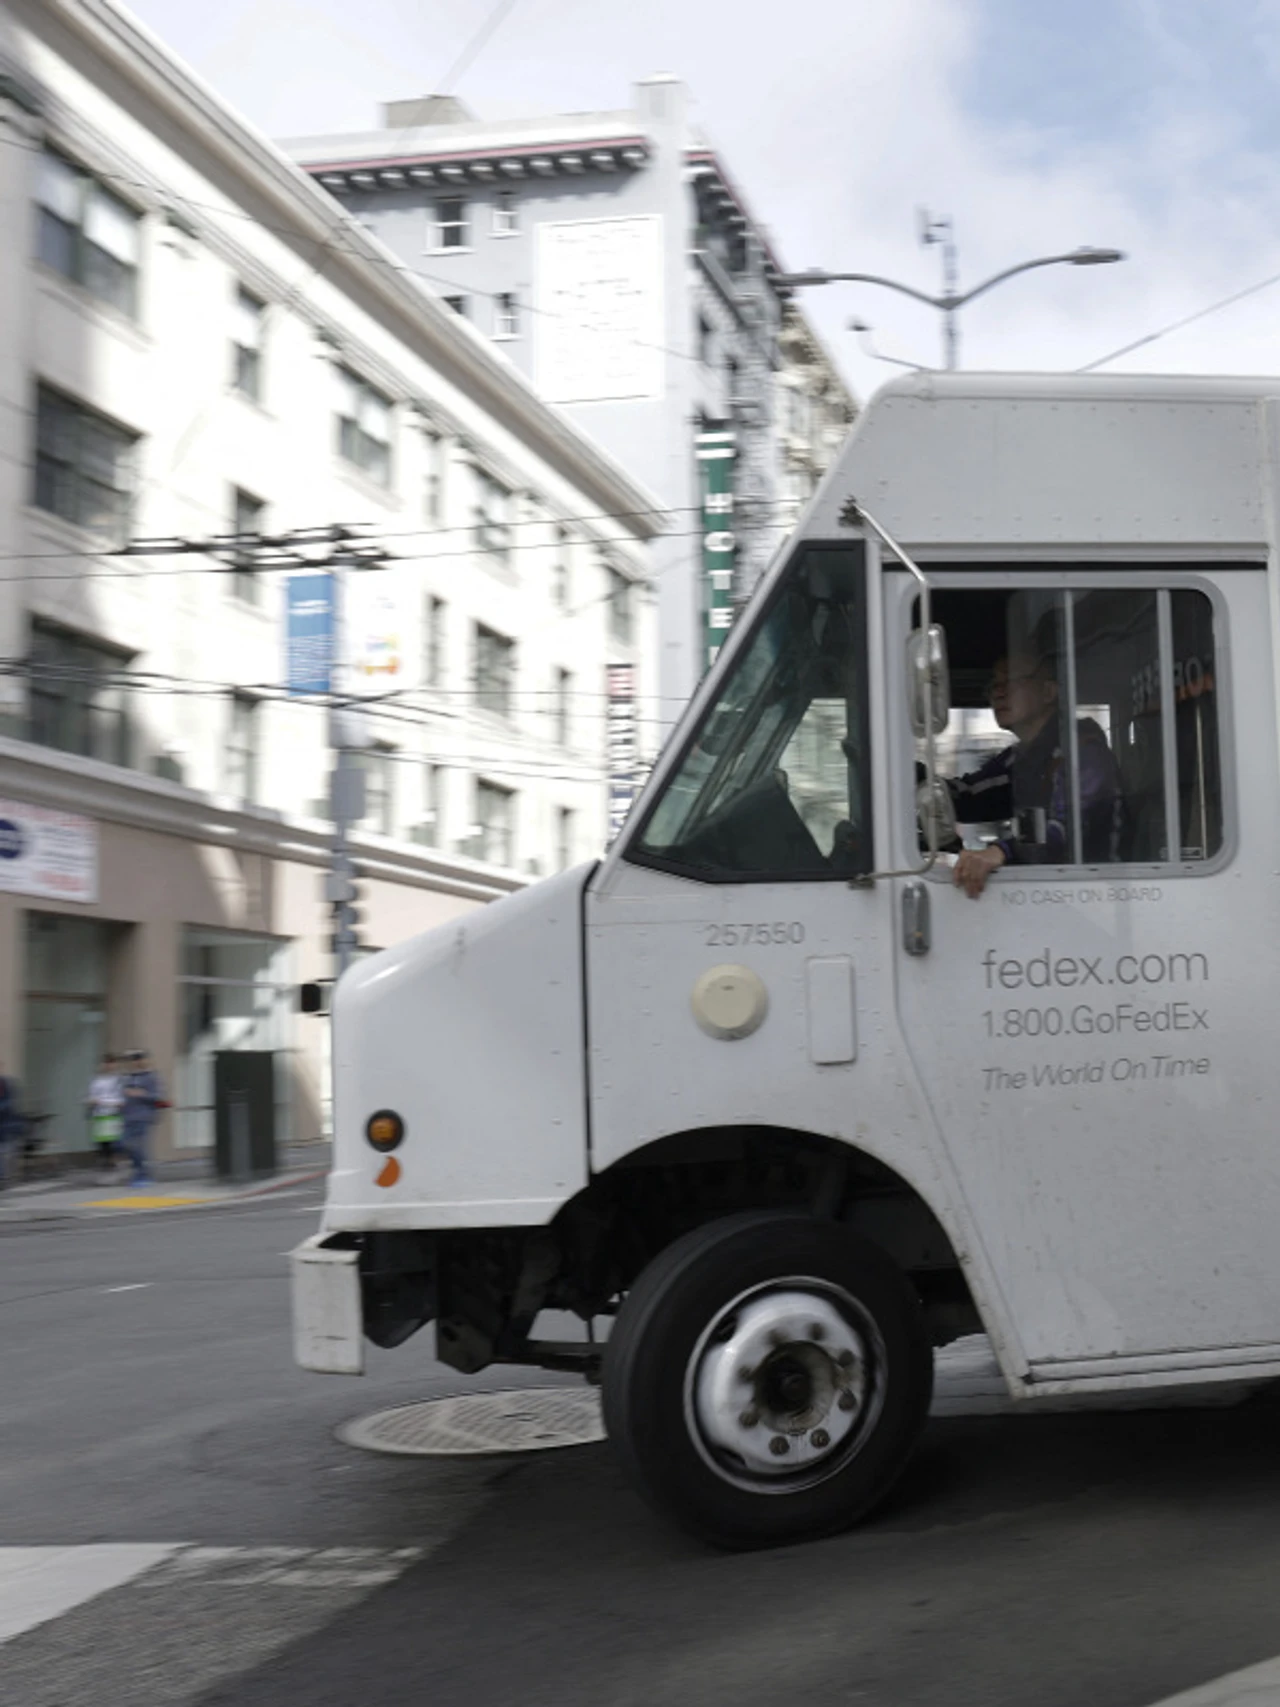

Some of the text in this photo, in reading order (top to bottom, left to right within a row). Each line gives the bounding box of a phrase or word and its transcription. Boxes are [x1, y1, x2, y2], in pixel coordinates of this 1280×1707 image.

[1001, 887, 1163, 905] NO CASH ON BOARD
[705, 921, 806, 946] 257550
[981, 948, 1209, 989] fedex.com
[981, 1003, 1210, 1037] 1.800.GoFedEx
[982, 1055, 1210, 1091] The World On Time
